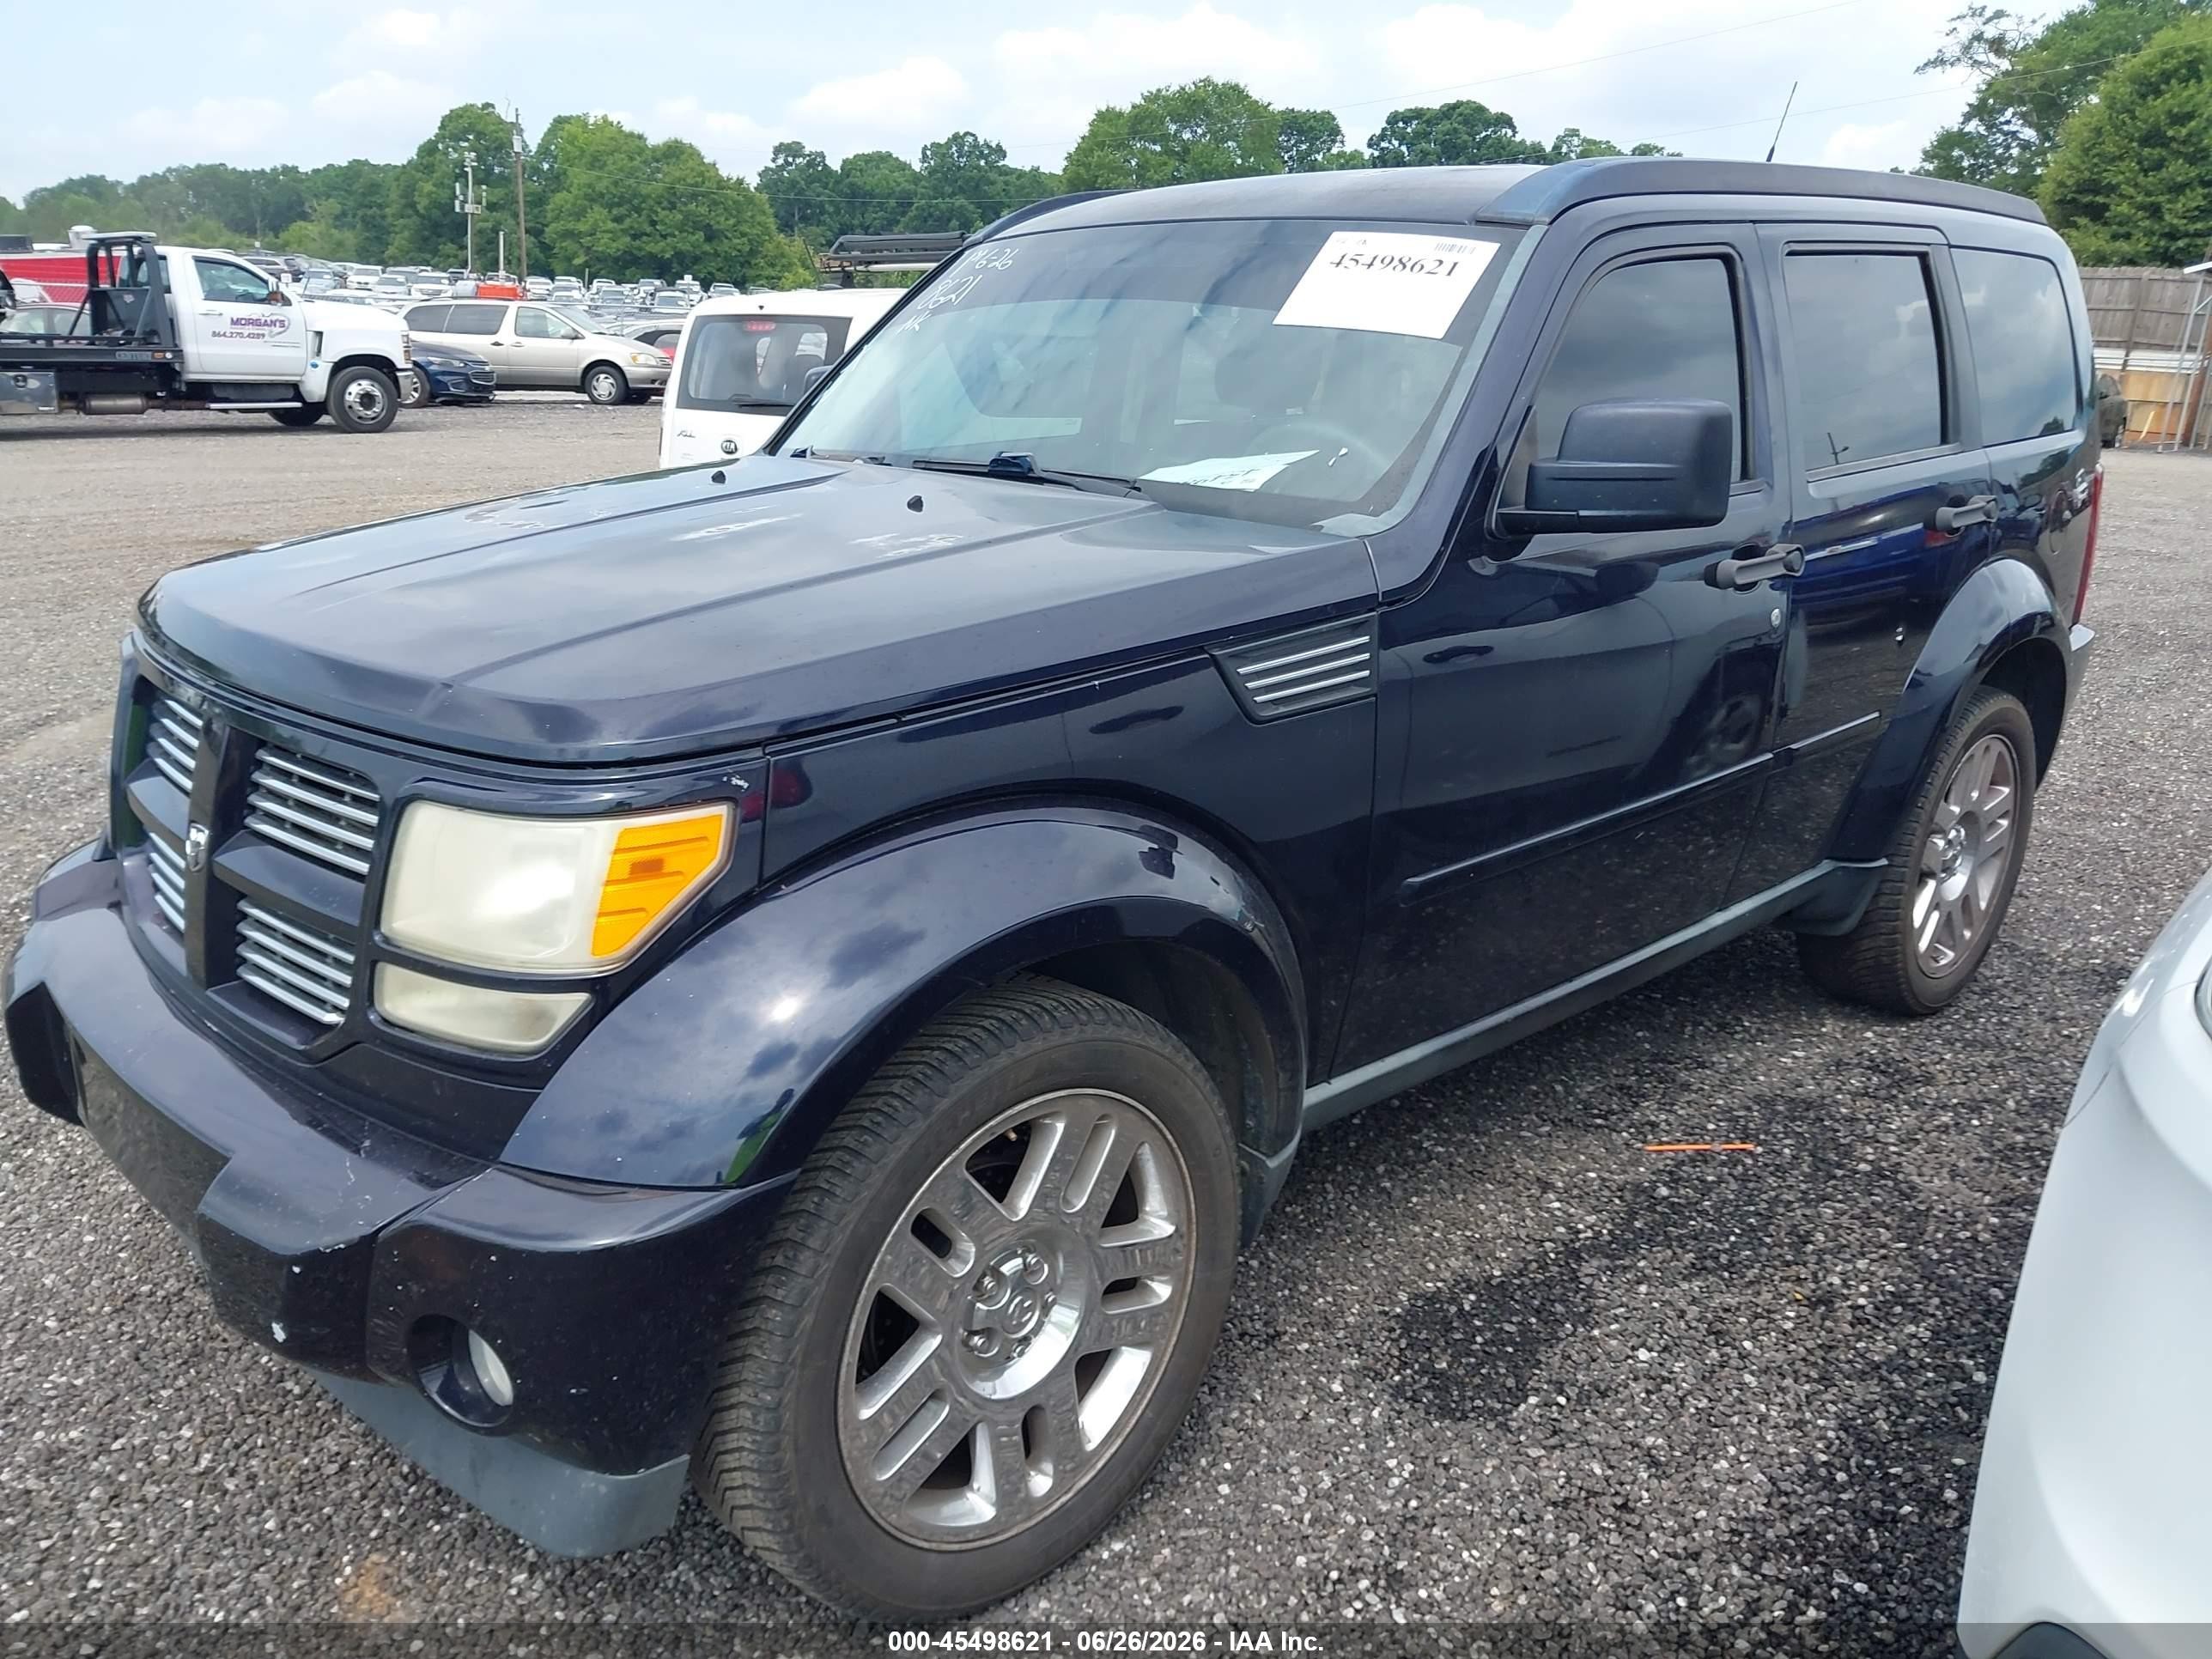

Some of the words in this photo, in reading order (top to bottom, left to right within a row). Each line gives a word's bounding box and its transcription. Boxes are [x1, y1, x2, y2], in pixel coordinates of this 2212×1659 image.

[1329, 252, 1460, 277] 45498621
[917, 274, 983, 310] 8621
[230, 316, 286, 329] MORGAN'S
